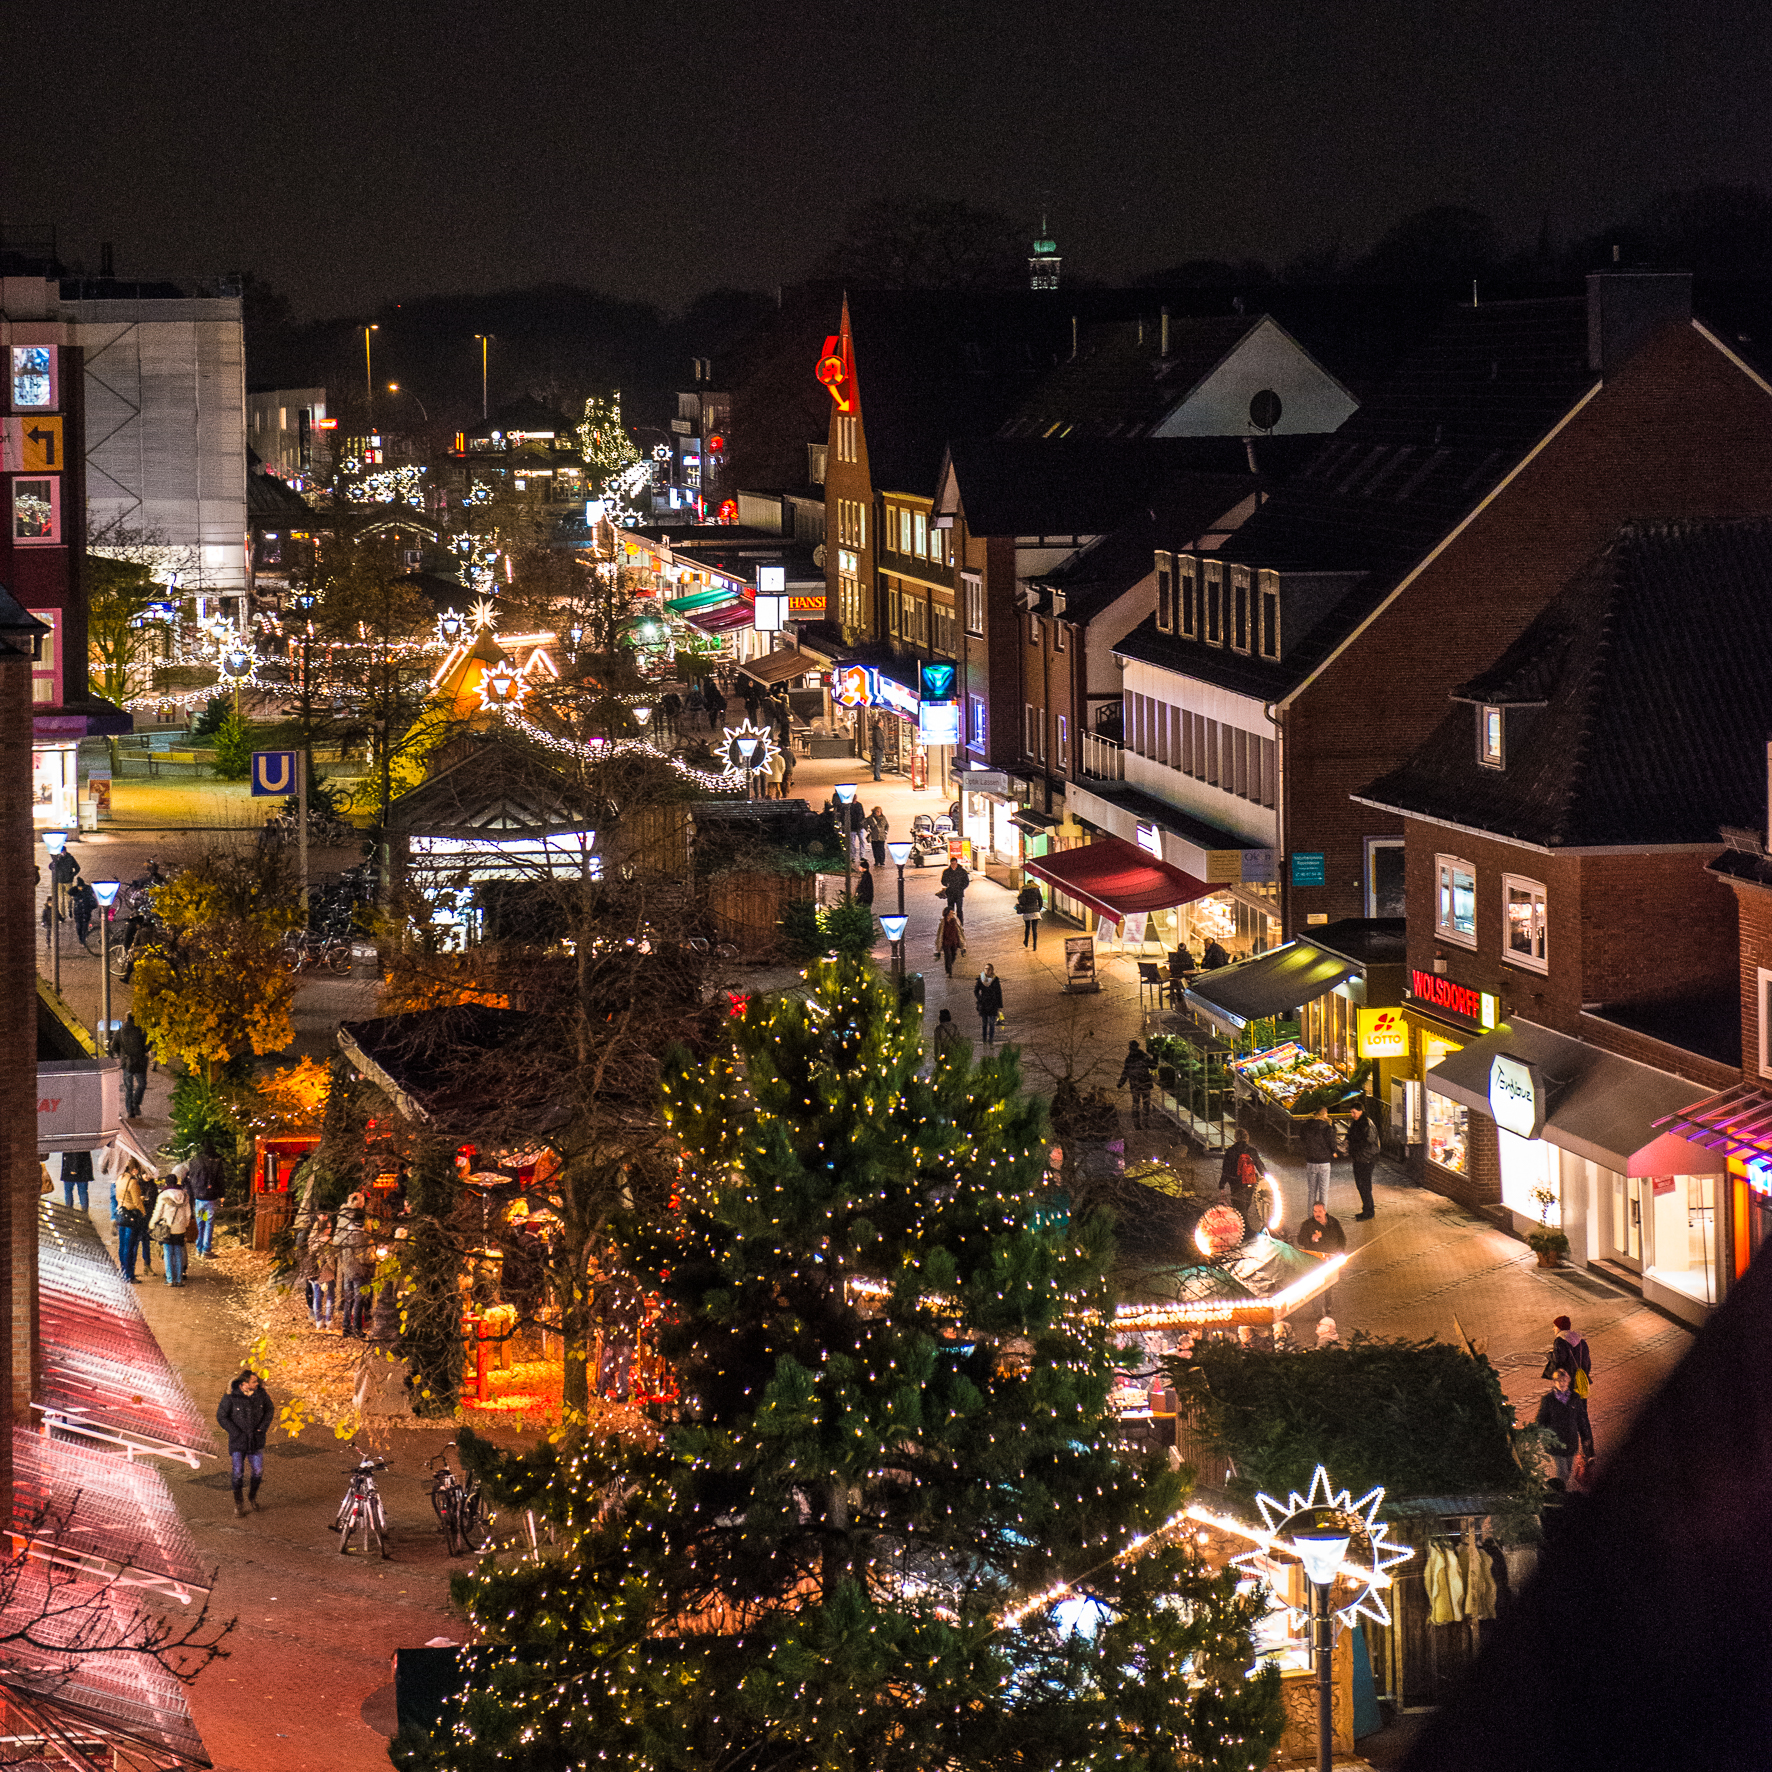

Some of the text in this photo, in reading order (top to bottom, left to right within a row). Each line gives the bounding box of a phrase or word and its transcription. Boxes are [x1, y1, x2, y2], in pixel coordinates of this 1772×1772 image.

[258, 755, 290, 792] U
[1412, 969, 1480, 1019] WOLSDORFF
[1367, 1034, 1403, 1046] LOTTO
[37, 1098, 62, 1113] AY
